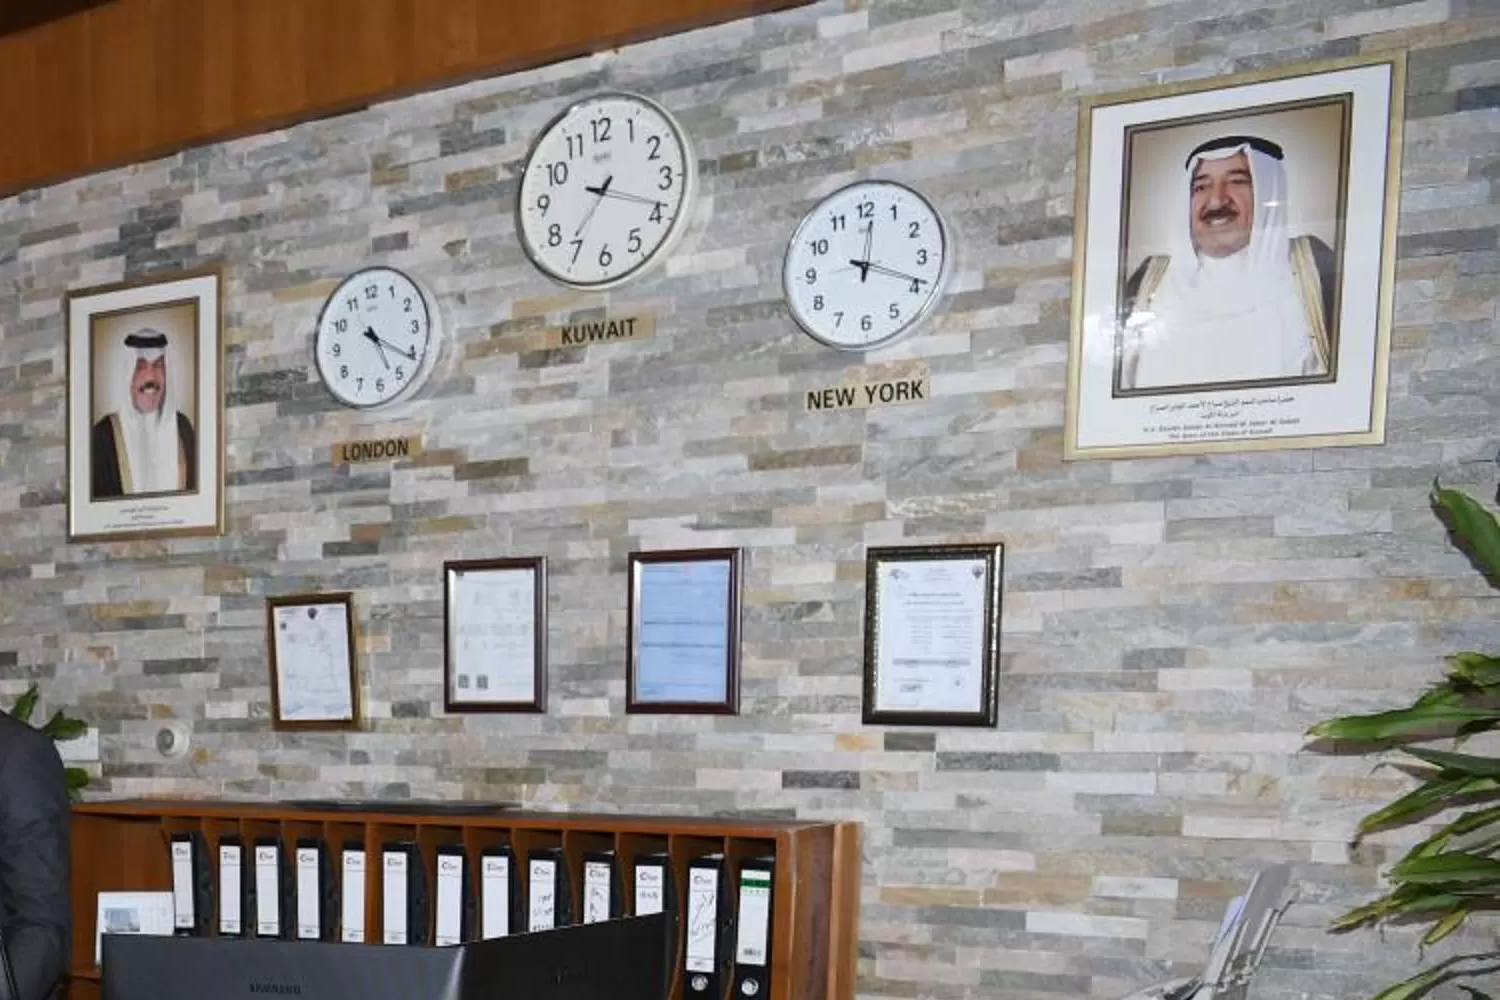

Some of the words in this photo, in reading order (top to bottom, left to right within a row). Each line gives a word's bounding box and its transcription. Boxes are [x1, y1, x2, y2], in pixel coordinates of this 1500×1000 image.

[590, 117, 612, 143] 12
[627, 118, 634, 142] 1
[566, 134, 583, 160] 11
[647, 135, 661, 161] 2
[546, 161, 568, 187] 10
[658, 165, 673, 191] 3
[537, 194, 550, 218] 9
[648, 201, 662, 224] 4
[856, 201, 875, 218] 12
[890, 204, 897, 221] 1
[830, 215, 845, 232] 11
[909, 222, 920, 238] 2
[548, 223, 562, 247] 8
[627, 228, 642, 253] 5
[569, 239, 583, 264] 7
[599, 243, 612, 267] 6
[810, 239, 828, 256] 10
[917, 249, 927, 265] 3
[805, 268, 817, 285] 9
[365, 285, 378, 299] 12
[389, 285, 396, 299] 1
[909, 278, 920, 294] 4
[347, 298, 359, 312] 11
[404, 297, 412, 313] 2
[813, 295, 824, 311] 8
[889, 303, 900, 319] 5
[332, 319, 347, 334] 10
[411, 320, 419, 334] 3
[833, 311, 844, 328] 7
[861, 315, 872, 331] 6
[561, 317, 637, 344] KUWAIT
[333, 343, 340, 357] 9
[340, 365, 349, 379] 8
[396, 366, 404, 380] 5
[356, 377, 364, 391] 7
[376, 378, 385, 393] 6
[807, 387, 855, 410] NEW
[865, 379, 923, 405] YORK
[342, 438, 409, 461] LONDON
